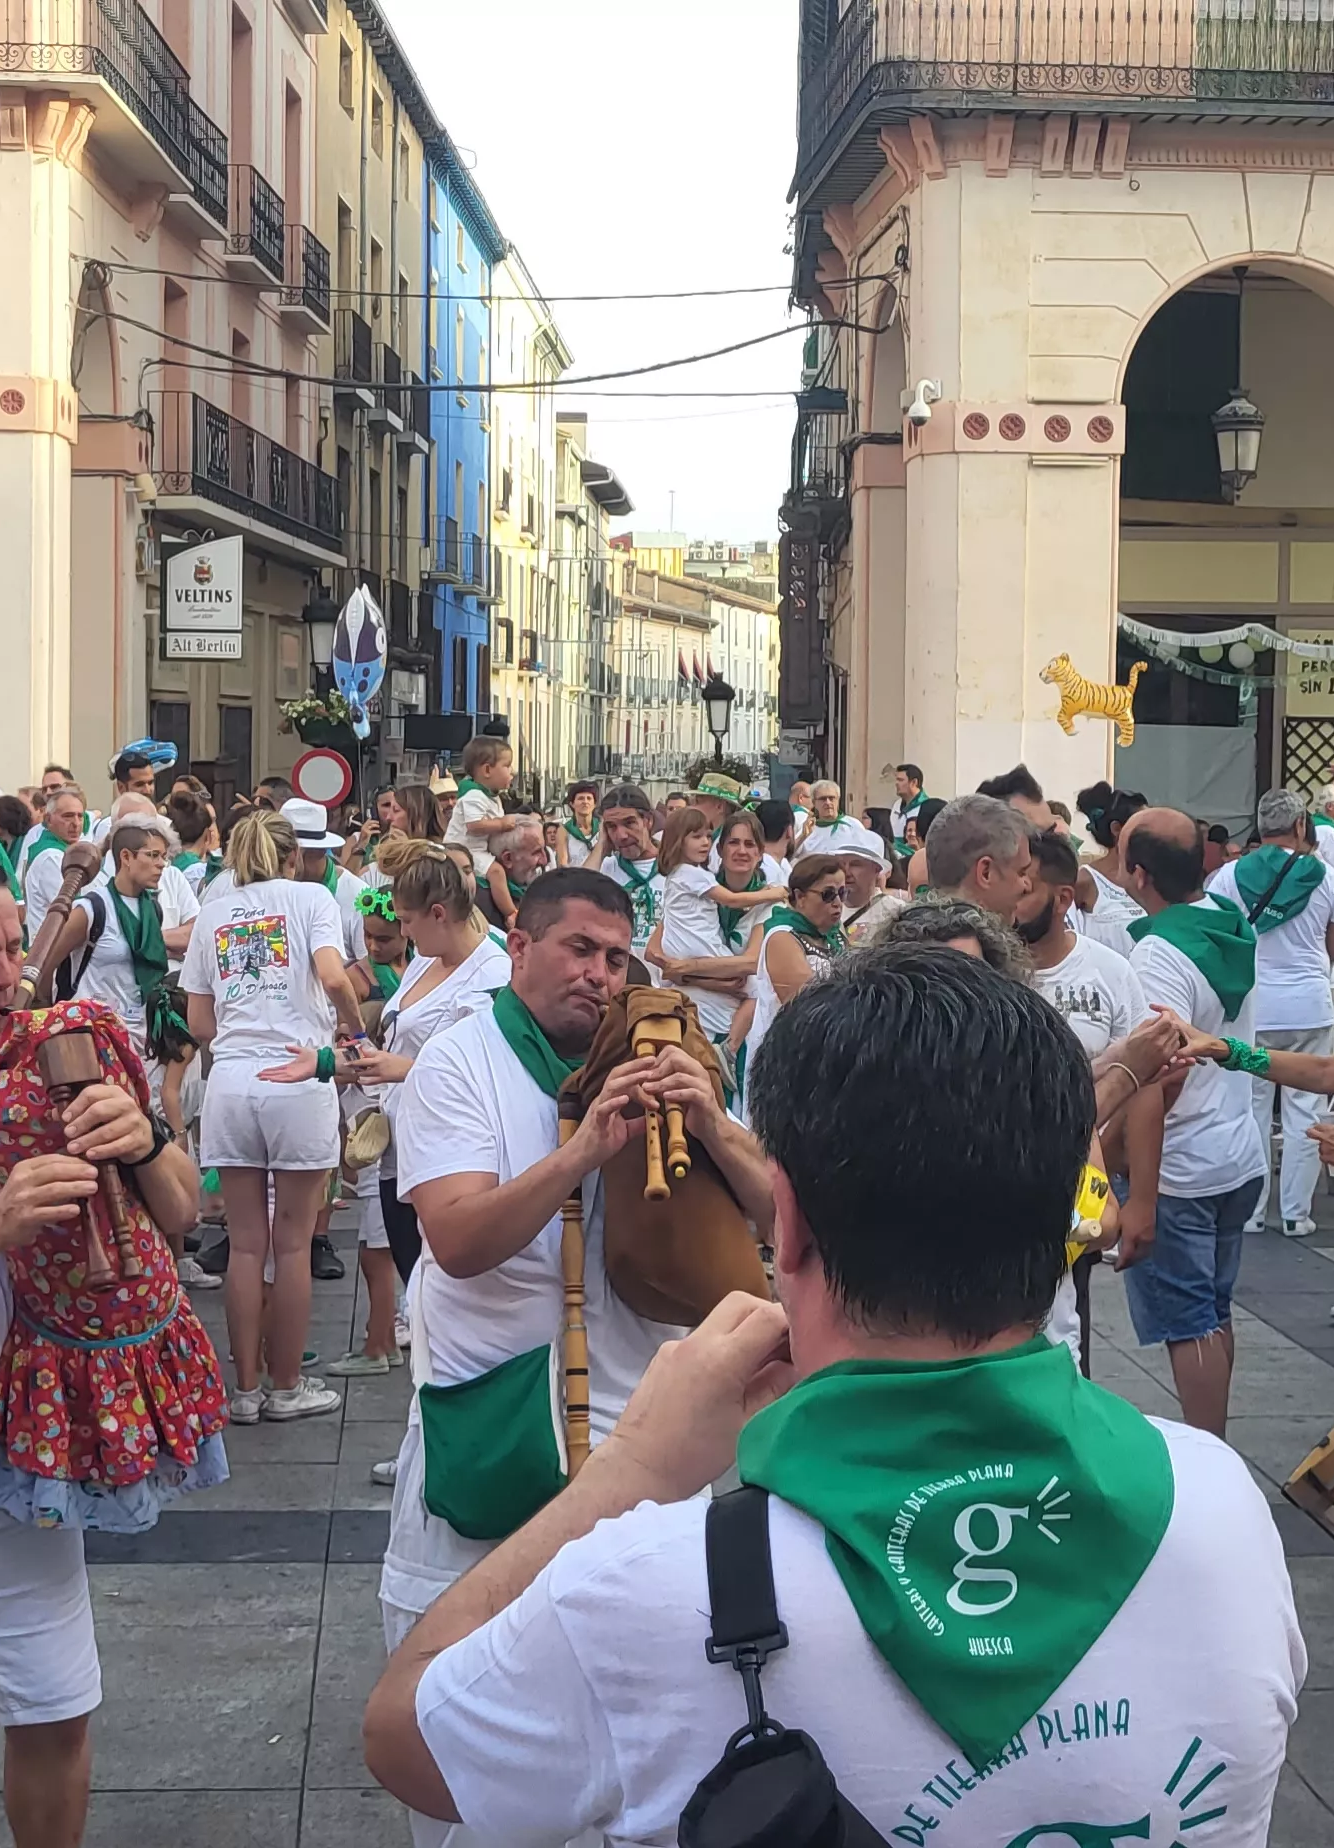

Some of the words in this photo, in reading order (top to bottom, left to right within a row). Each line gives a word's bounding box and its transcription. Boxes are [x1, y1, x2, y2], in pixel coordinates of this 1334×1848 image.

[175, 588, 233, 603] VELTINS
[172, 638, 191, 652] Alt
[196, 638, 236, 653] Berlin
[1299, 679, 1322, 694] SIN
[226, 983, 241, 1000] 10
[968, 1463, 1014, 1483] PLANA
[918, 1474, 967, 1497] TIERRA
[904, 1491, 928, 1512] DE
[887, 1509, 916, 1574] GAITERAS
[904, 1587, 945, 1636] GAITERS
[969, 1636, 1014, 1656] HUESCA
[891, 1803, 940, 1847] DE
[1036, 1698, 1130, 1749] PLANA
